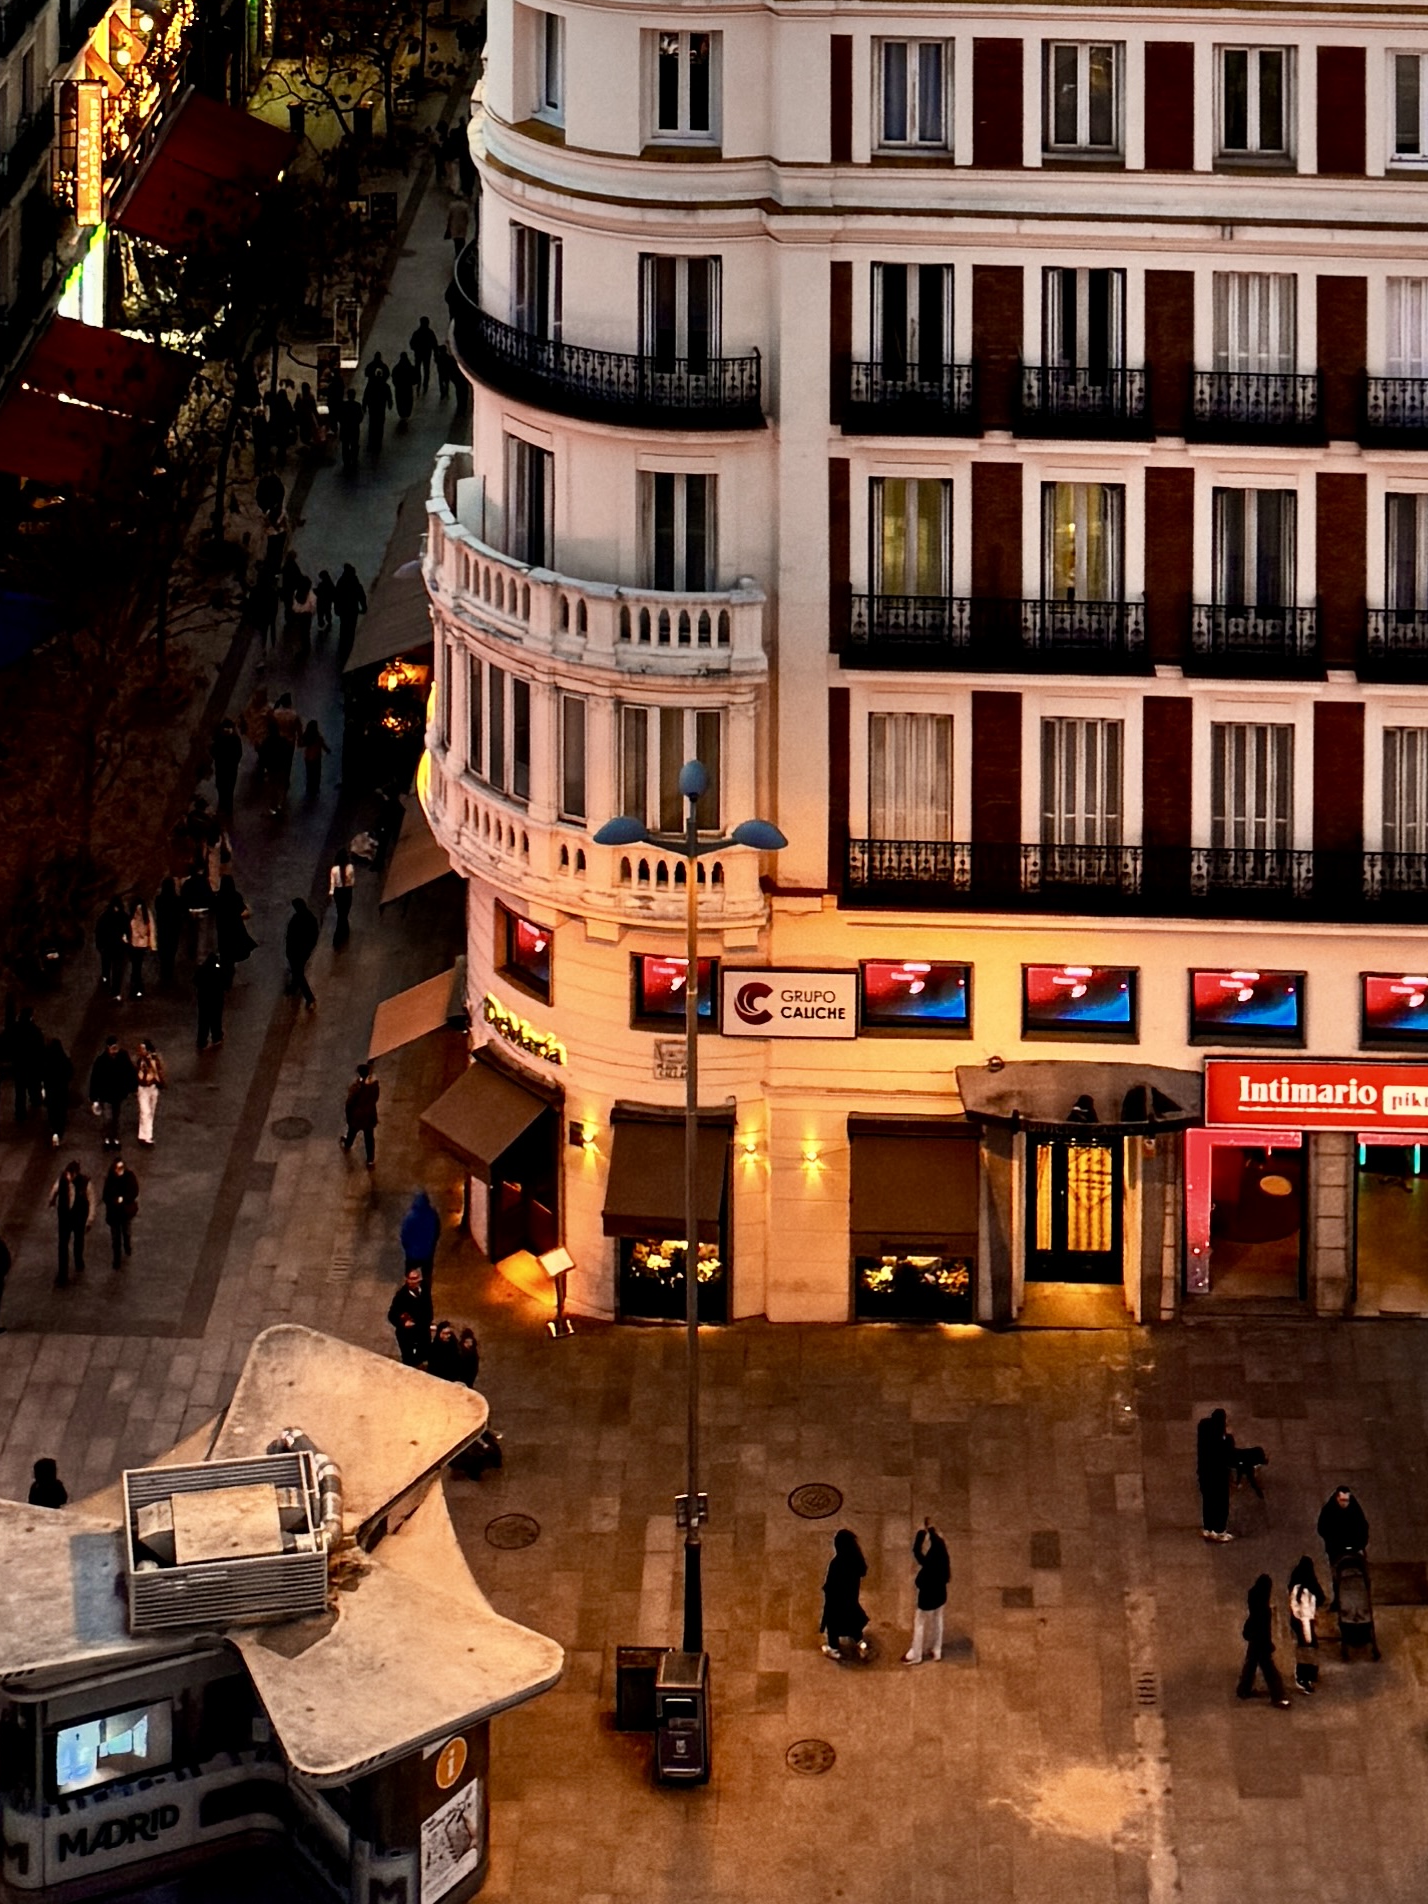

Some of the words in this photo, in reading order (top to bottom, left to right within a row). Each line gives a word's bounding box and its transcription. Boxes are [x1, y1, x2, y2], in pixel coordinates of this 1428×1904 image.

[780, 989, 836, 1004] GRUPO
[780, 1006, 847, 1020] CALICHE
[1238, 1075, 1378, 1105] Intimario
[57, 1803, 181, 1863] MADRID
